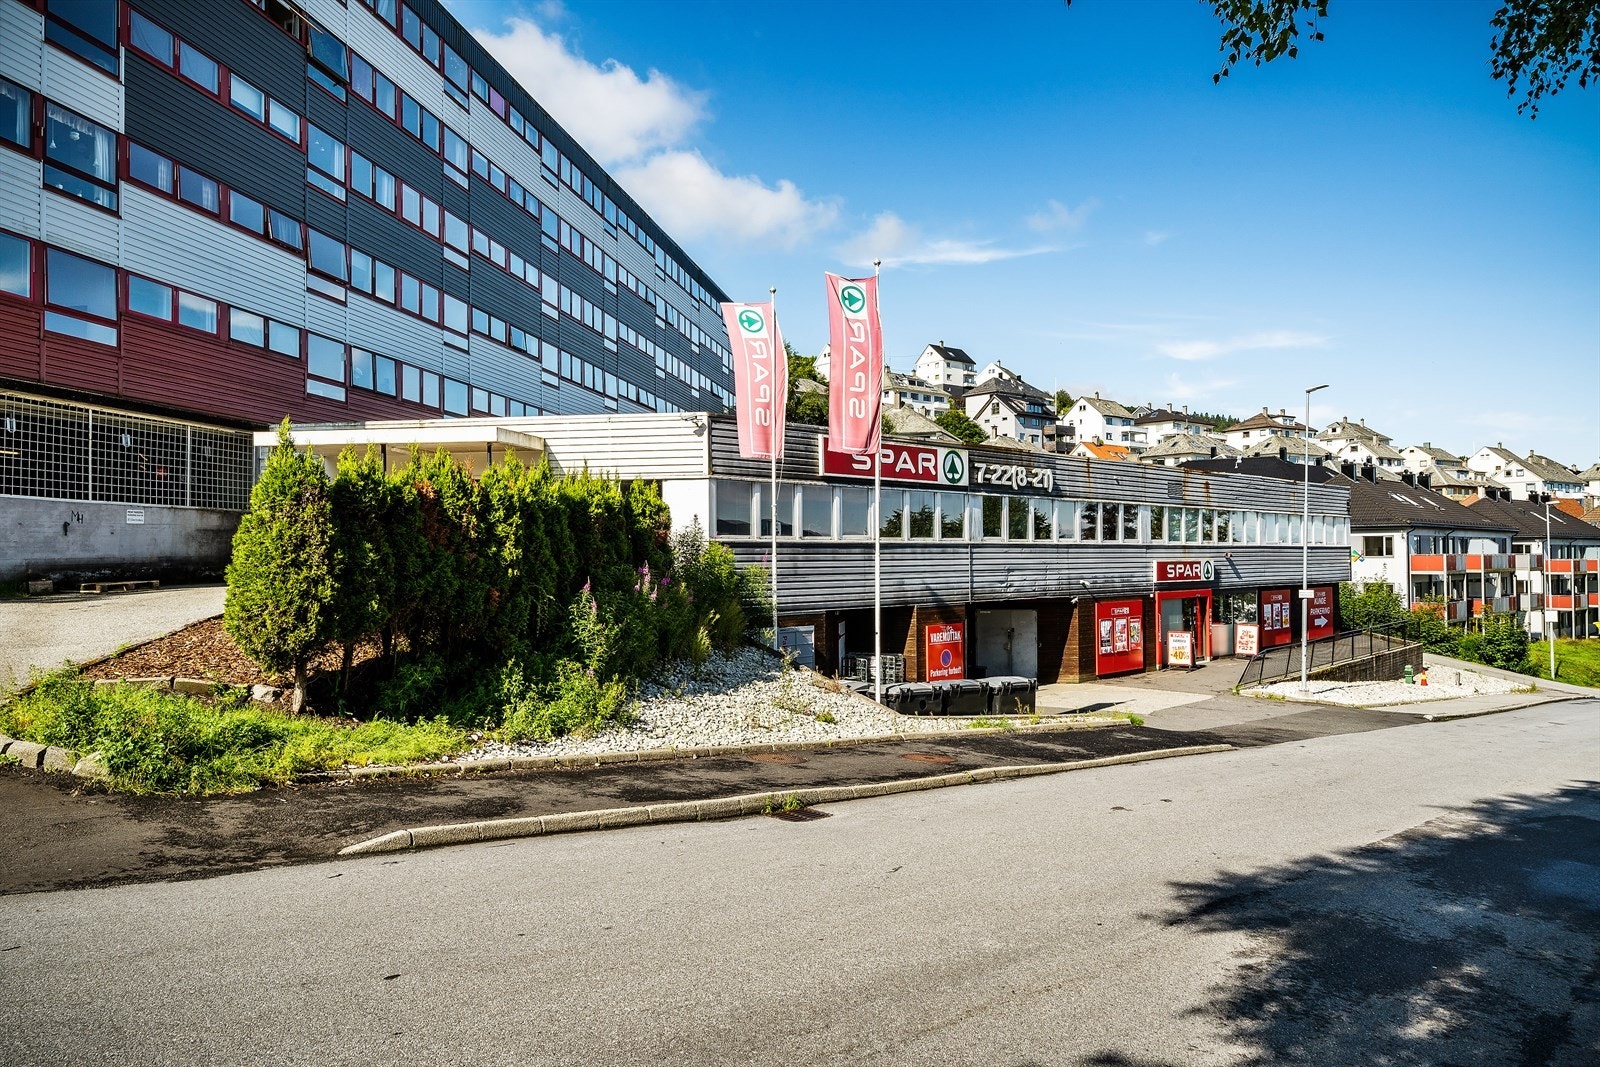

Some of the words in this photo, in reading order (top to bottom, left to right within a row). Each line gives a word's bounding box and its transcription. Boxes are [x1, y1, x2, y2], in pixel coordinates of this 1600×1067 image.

[852, 450, 936, 476] SPAR
[974, 463, 1054, 493] 7-22(8-21)
[1166, 563, 1201, 578] SPAR
[1309, 607, 1331, 616] PARKERING
[930, 668, 948, 677] Parkering
